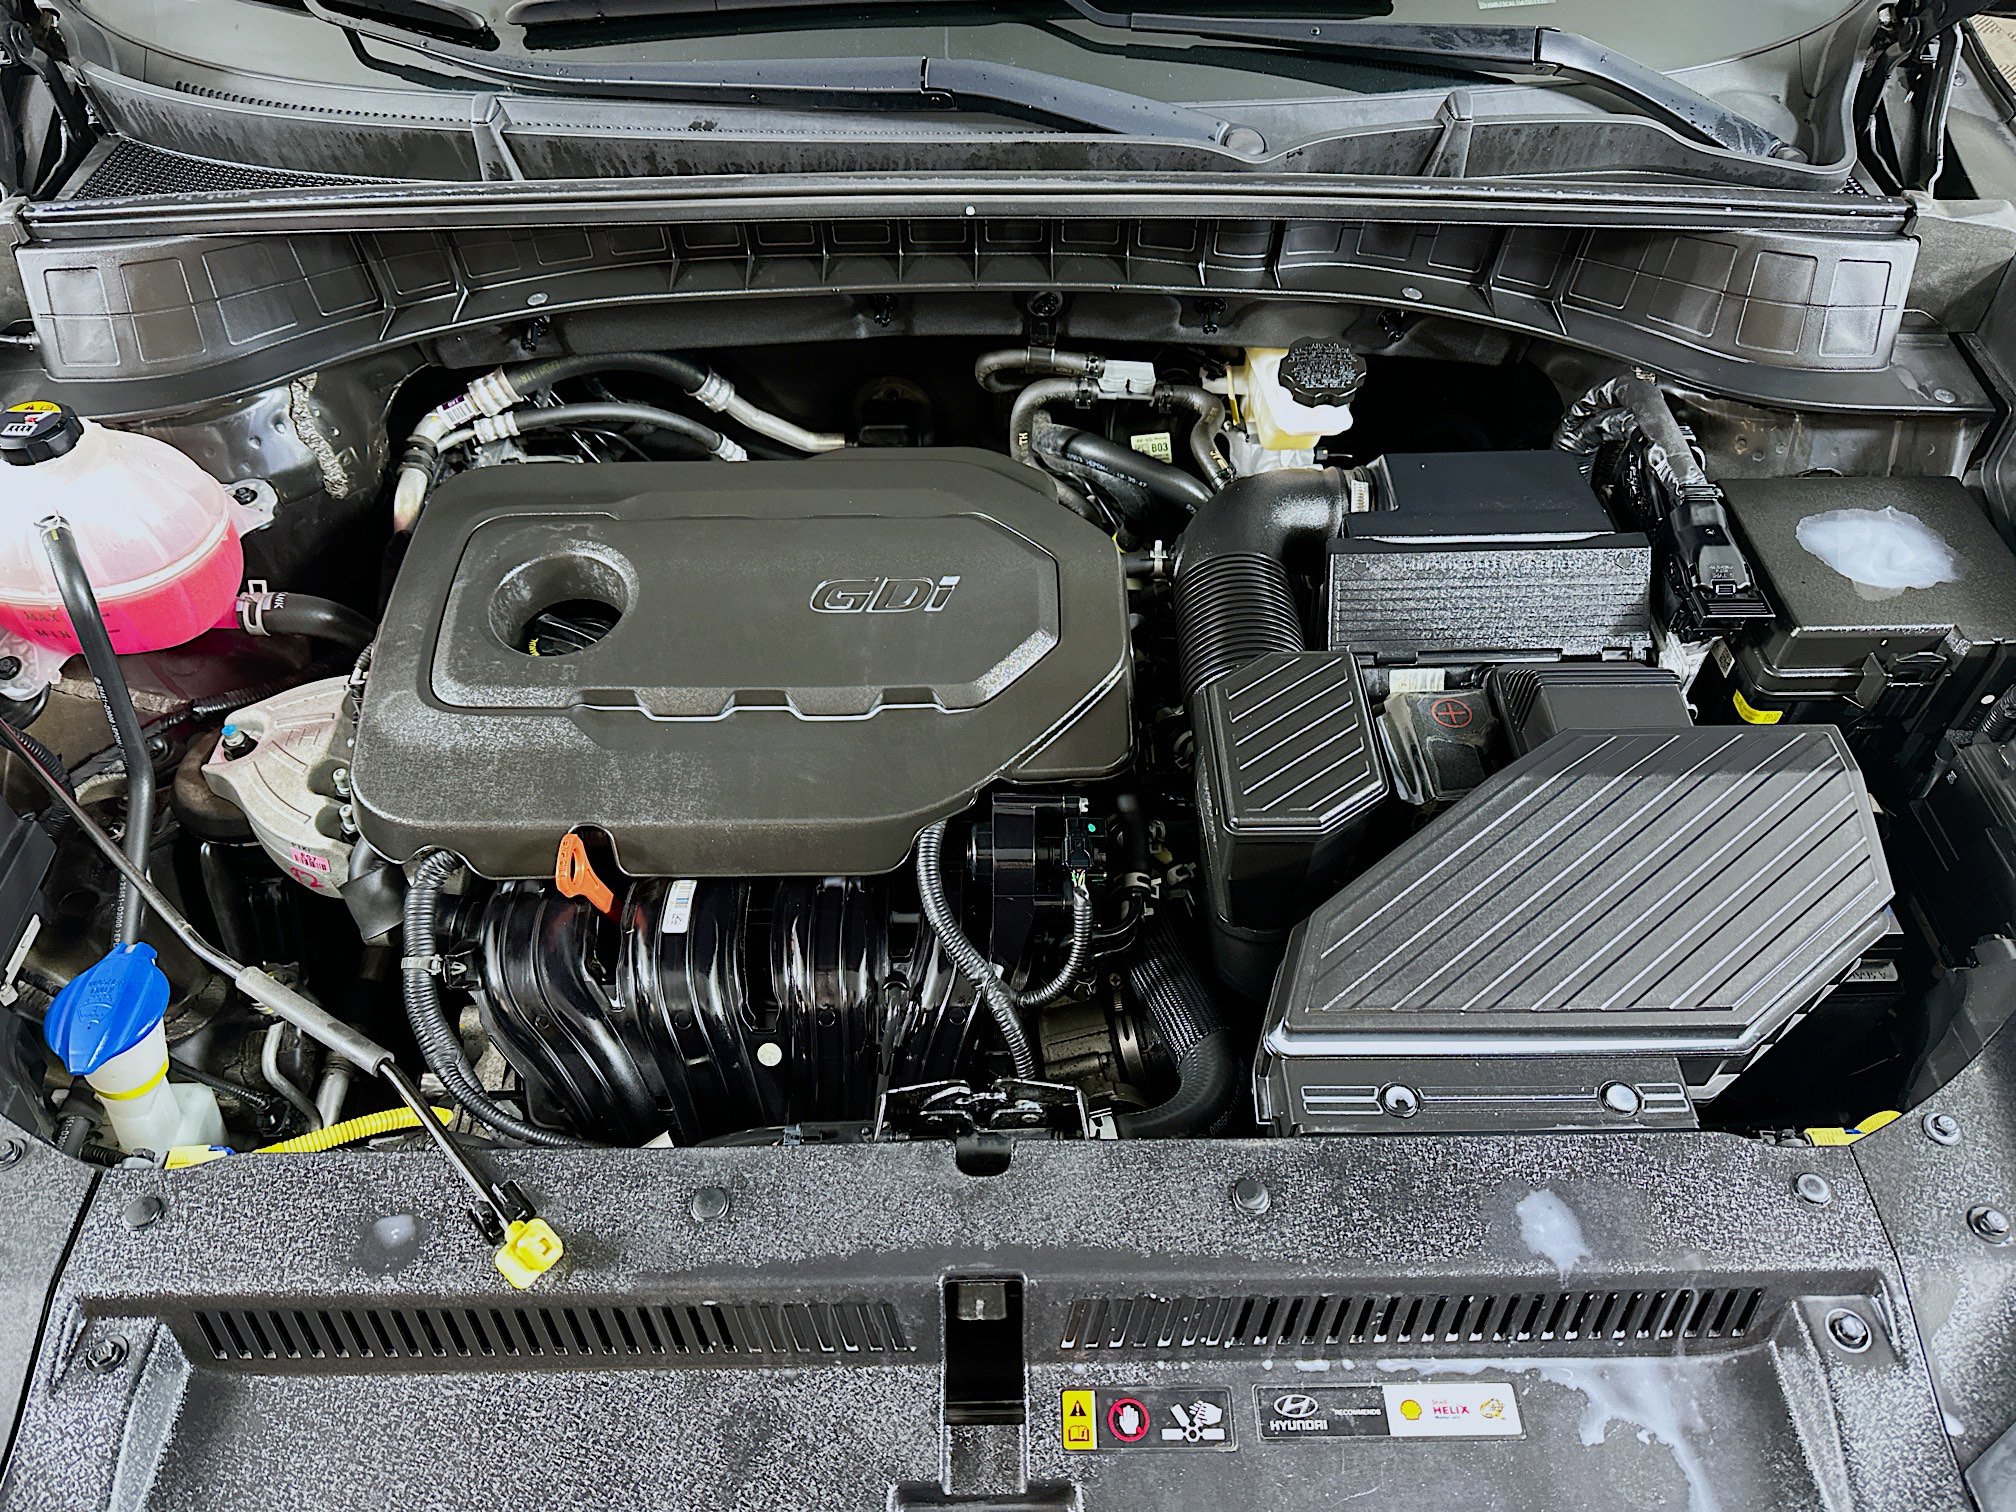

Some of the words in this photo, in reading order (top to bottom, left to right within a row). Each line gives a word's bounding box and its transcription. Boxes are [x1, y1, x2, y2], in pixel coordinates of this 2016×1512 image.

[1151, 442, 1169, 453] B03
[809, 575, 961, 613] GDi
[24, 611, 60, 622] MAX
[34, 629, 71, 639] MIN
[1433, 1405, 1470, 1415] HELIX
[1269, 1419, 1329, 1431] HYUNDAI
